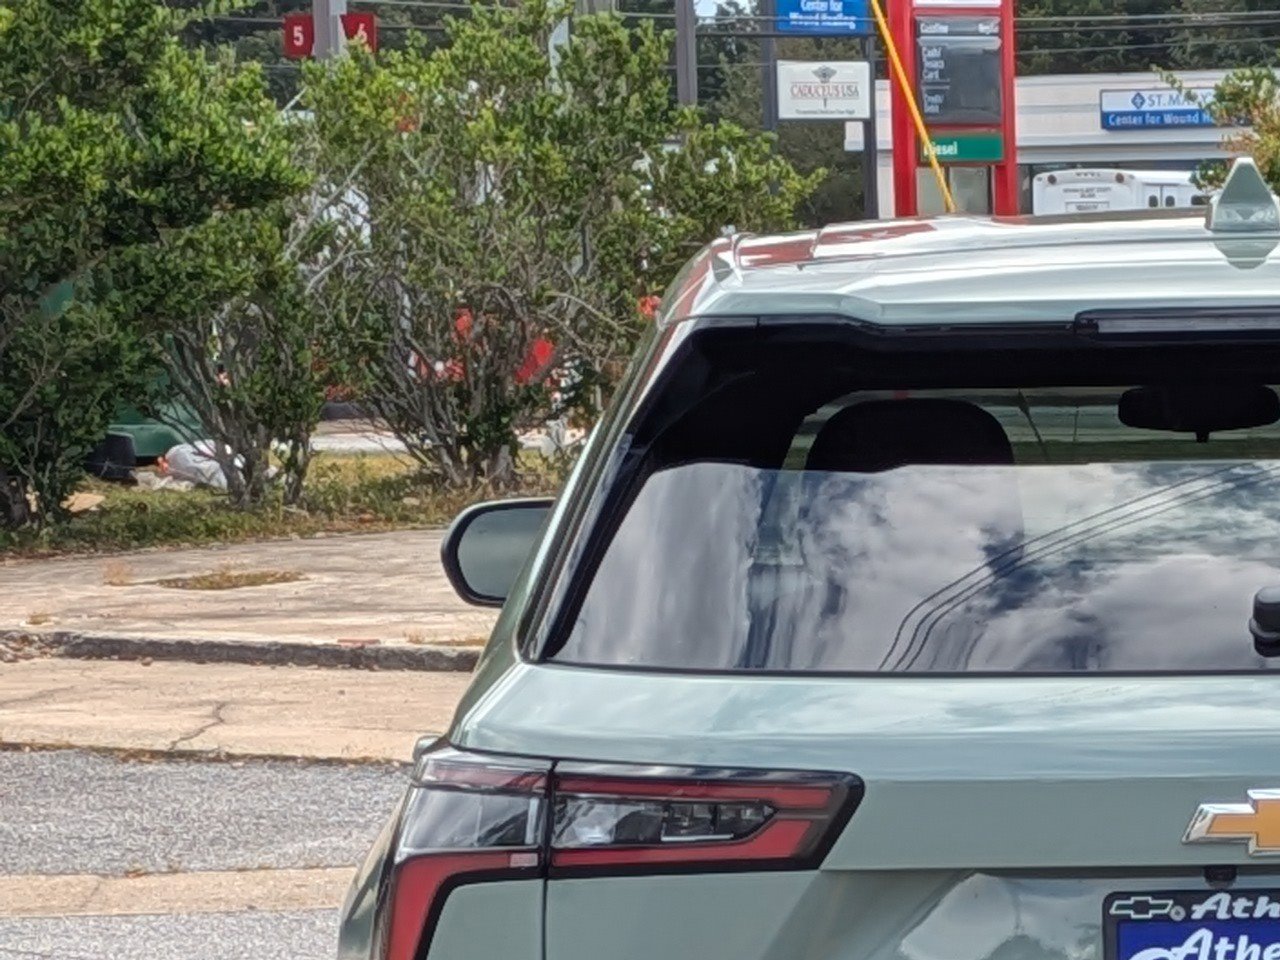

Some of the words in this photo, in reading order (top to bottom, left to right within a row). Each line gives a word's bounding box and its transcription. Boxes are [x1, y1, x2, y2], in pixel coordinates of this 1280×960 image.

[293, 25, 304, 47] 5
[1147, 94, 1167, 107] ST.
[1108, 114, 1143, 125] Center
[1145, 113, 1160, 124] for
[1163, 112, 1199, 124] Wound
[924, 141, 958, 156] iesel
